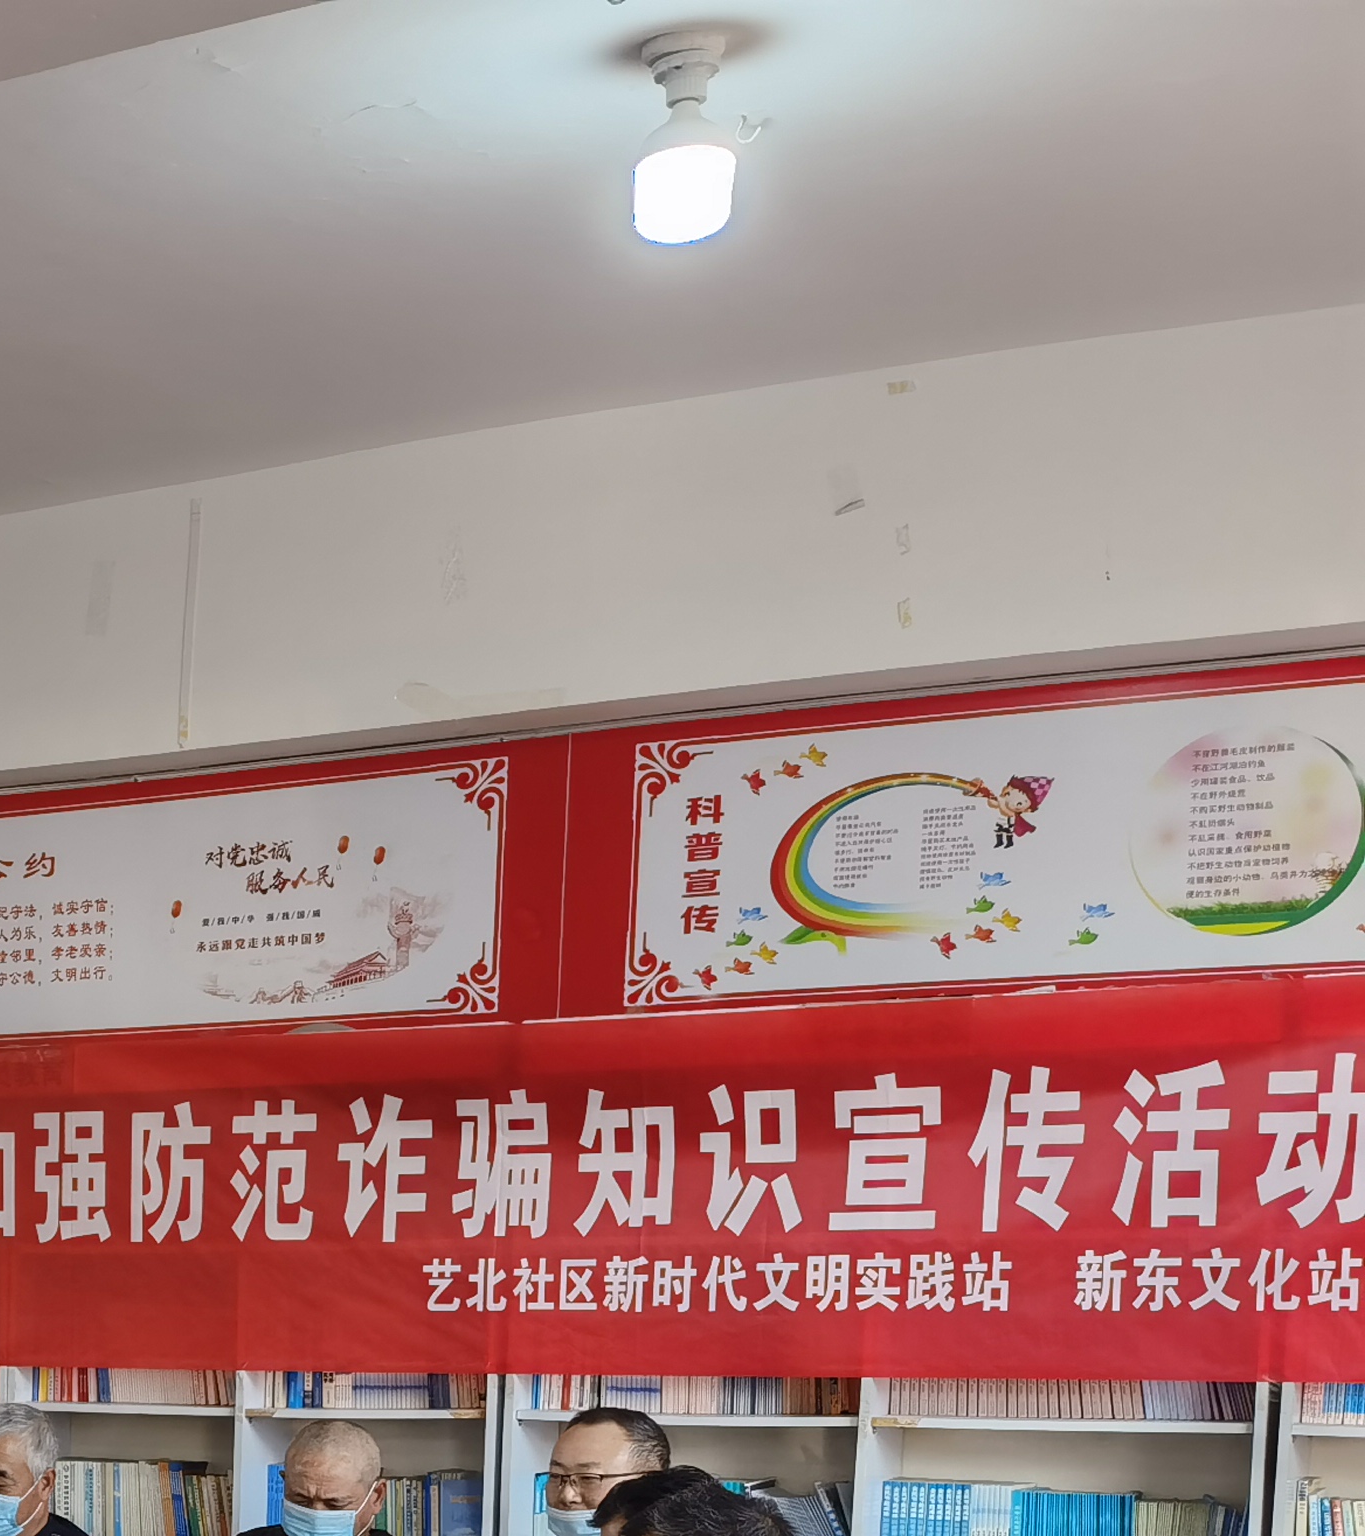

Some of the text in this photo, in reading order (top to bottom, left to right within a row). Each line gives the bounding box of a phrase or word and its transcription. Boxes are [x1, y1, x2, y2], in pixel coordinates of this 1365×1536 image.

[205, 839, 294, 869] 对党忠诚
[680, 792, 725, 936] 科普宣传
[245, 864, 335, 896] 服务人民
[195, 932, 327, 954] 永远跟党走共筑中国梦
[425, 1245, 1361, 1318] 艺北社区新时代文明实践站 新东文化站
